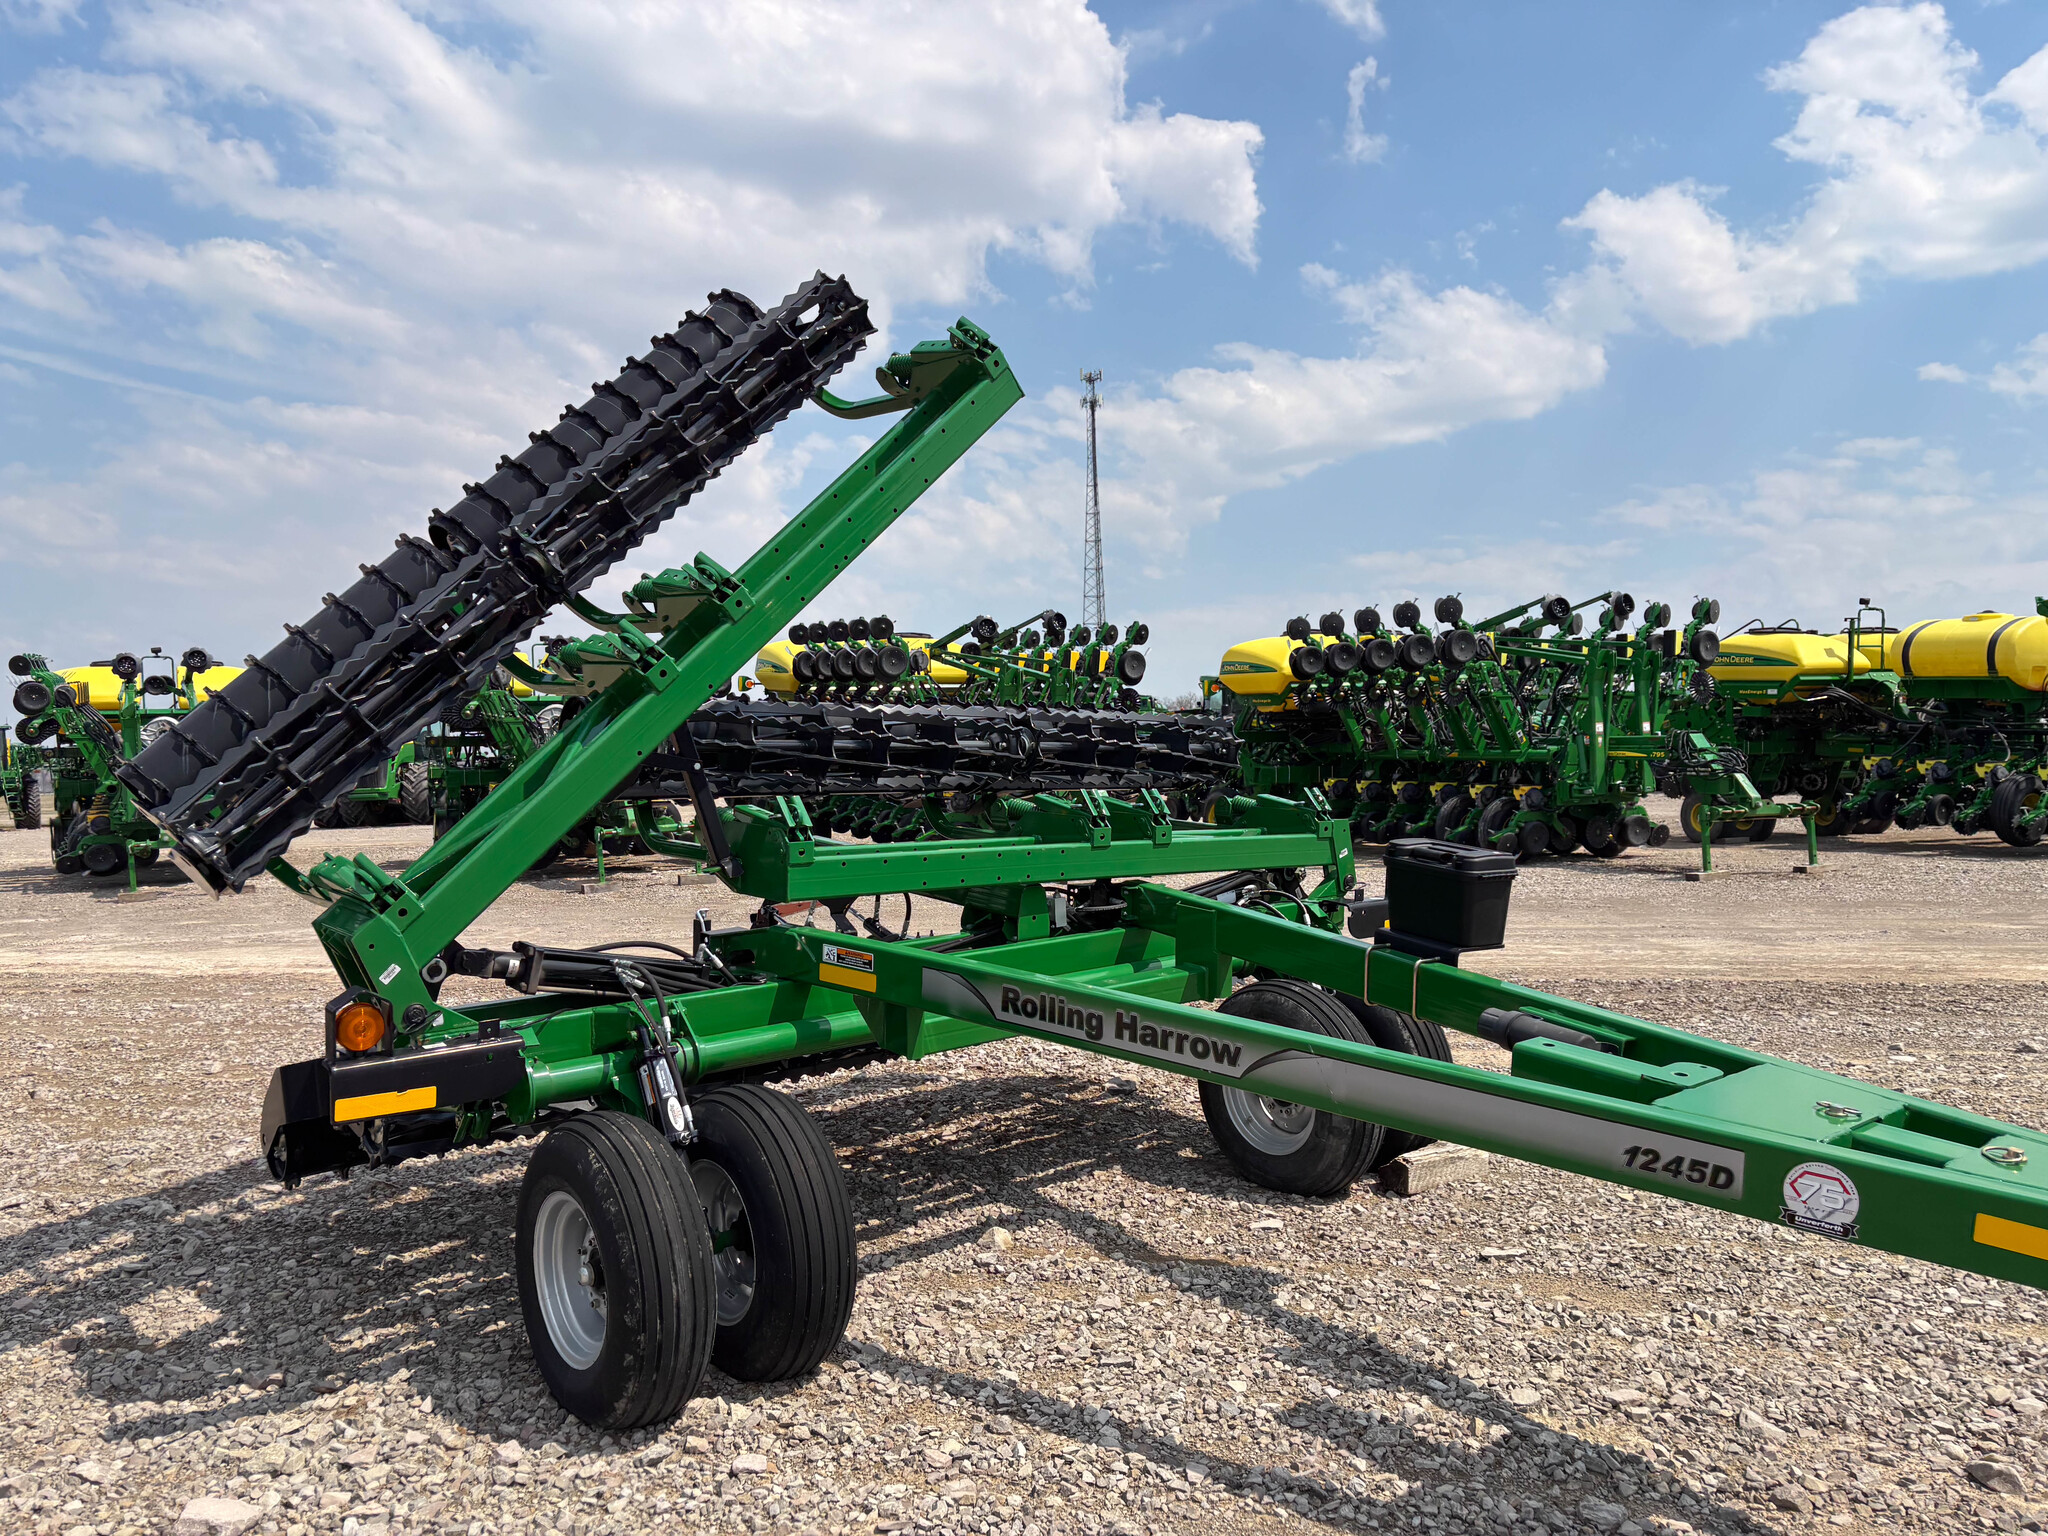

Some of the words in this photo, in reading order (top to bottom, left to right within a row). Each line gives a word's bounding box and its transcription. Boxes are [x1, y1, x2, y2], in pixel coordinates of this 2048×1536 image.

[1235, 663, 1250, 671] DEERE
[1730, 655, 1754, 663] DEERE
[1001, 984, 1104, 1041] Rolling
[1114, 1009, 1243, 1067] Harrow
[1621, 1145, 1735, 1190] 1245D
[1796, 1177, 1846, 1211] 75
[1794, 1215, 1844, 1232] Unverferth
